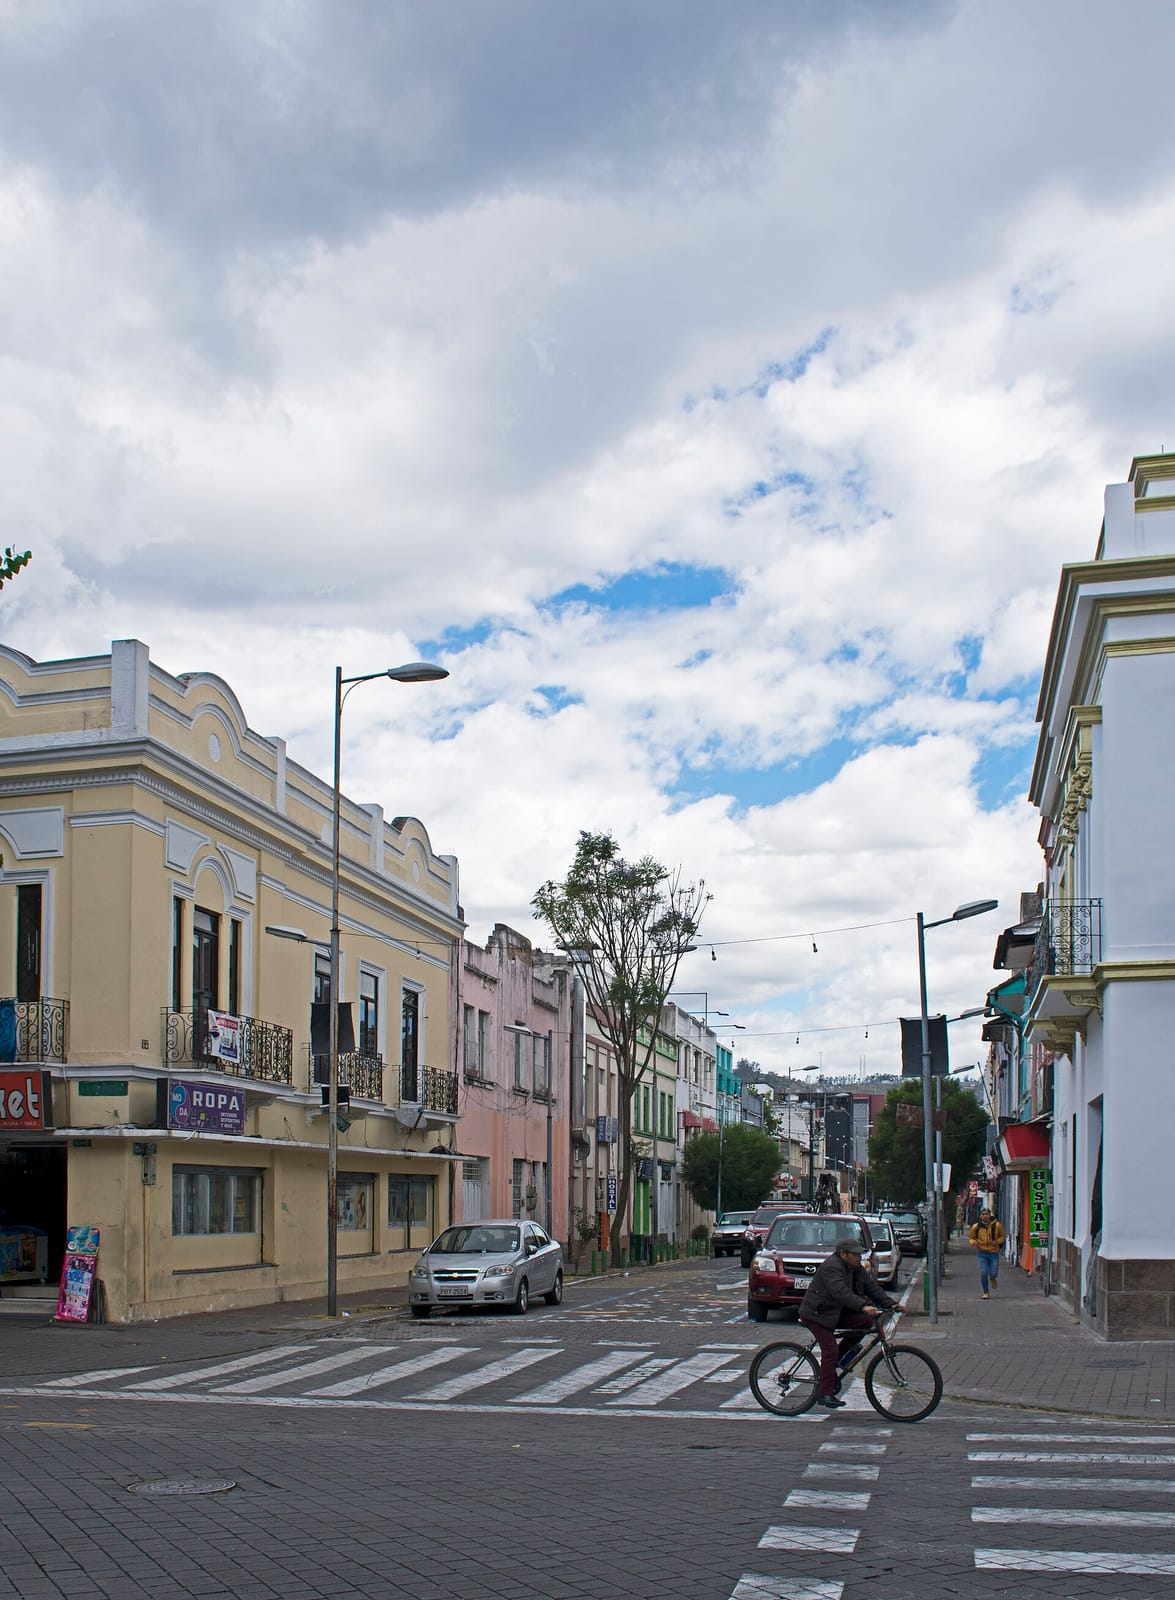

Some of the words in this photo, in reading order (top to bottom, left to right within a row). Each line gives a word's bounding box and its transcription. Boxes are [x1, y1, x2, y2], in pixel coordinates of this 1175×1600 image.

[172, 1093, 182, 1102] MO
[192, 1090, 240, 1111] ROPA
[180, 1107, 188, 1116] DA
[608, 1179, 616, 1209] HOSTAL
[1032, 1171, 1046, 1232] HOSTAL
